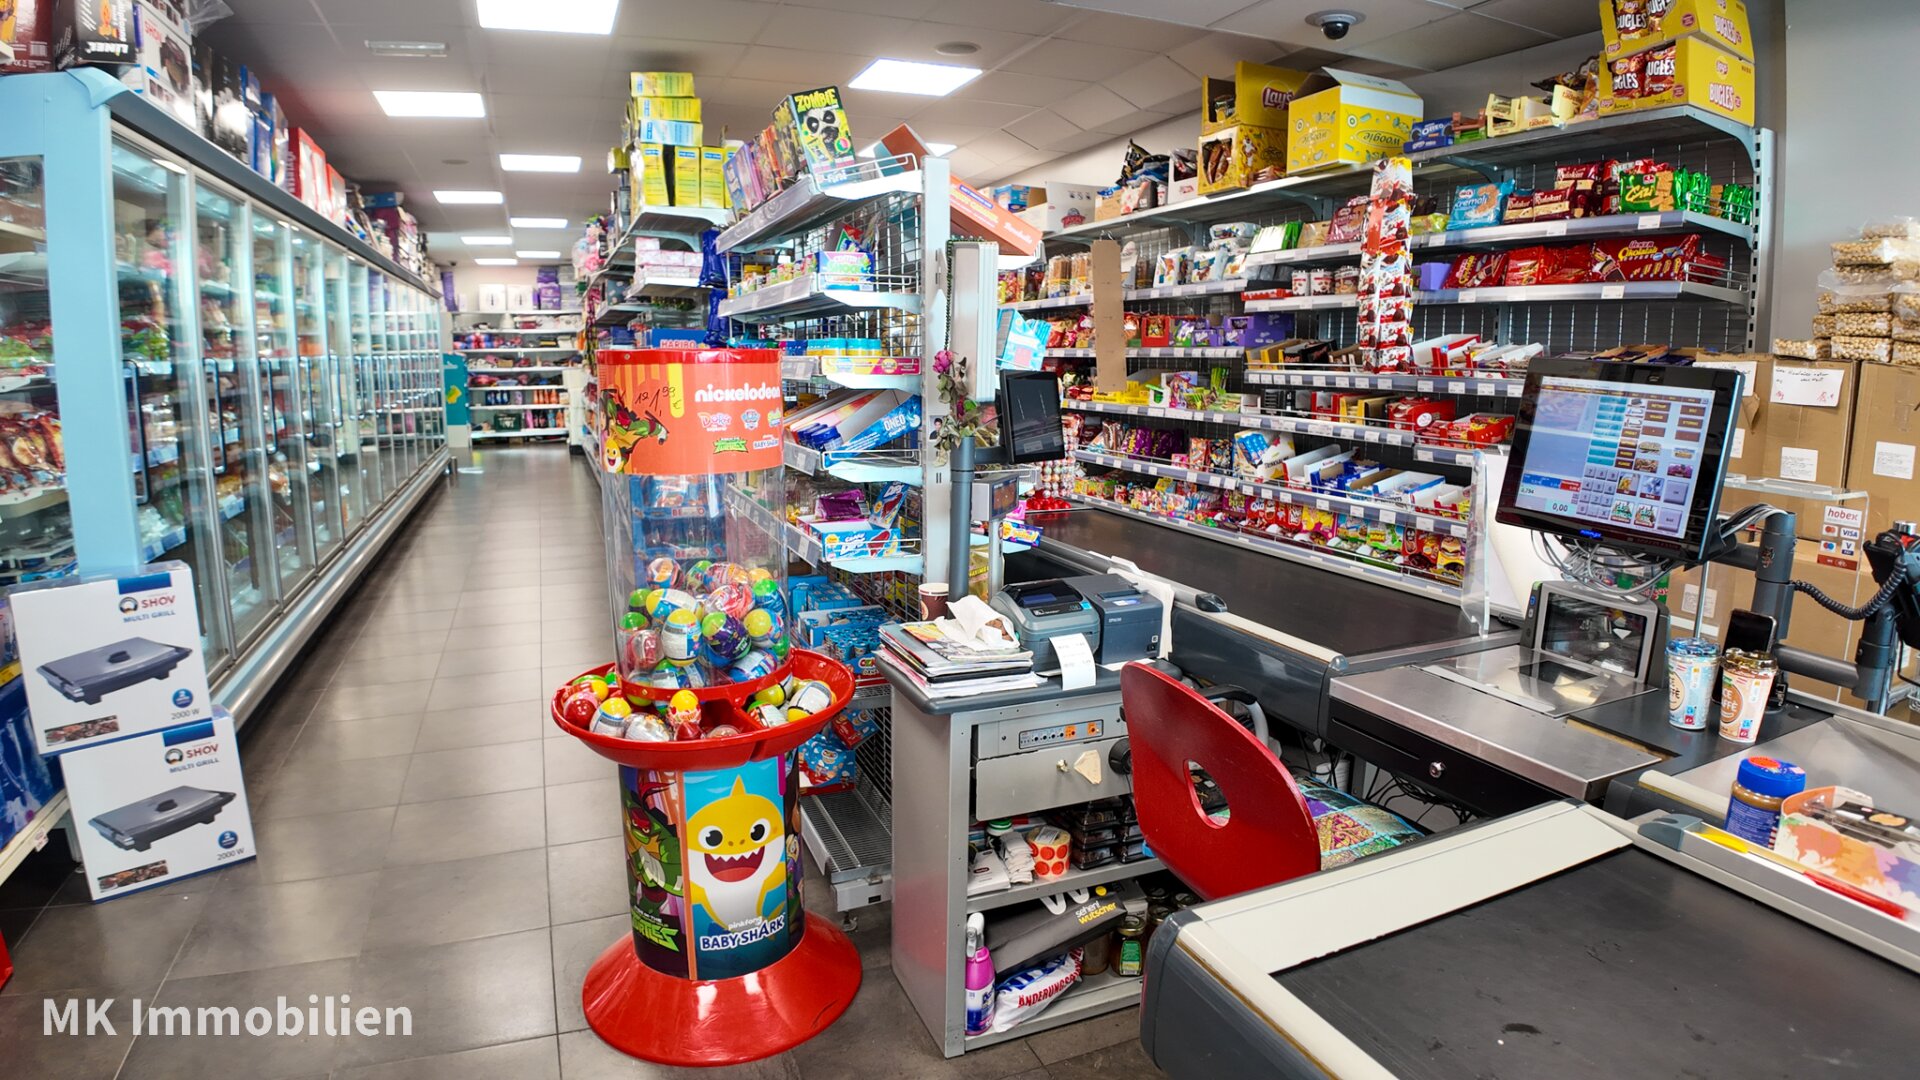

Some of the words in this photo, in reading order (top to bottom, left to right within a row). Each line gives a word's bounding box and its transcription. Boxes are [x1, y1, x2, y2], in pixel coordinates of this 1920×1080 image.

[794, 88, 838, 113] ZOMBIE
[1710, 82, 1735, 112] BUGLES
[1421, 124, 1444, 135] OREO
[660, 340, 695, 348] HARIBO
[695, 383, 781, 402] nickelodeon
[1552, 503, 1568, 512] 0,00
[1828, 508, 1859, 520] hobex
[1843, 530, 1858, 538] VISA
[141, 596, 176, 609] SHOV
[123, 614, 150, 623] MULTI
[152, 610, 176, 619] GRILL
[171, 710, 192, 720] 2000
[191, 707, 200, 716] W
[186, 744, 219, 758] SHOV
[169, 764, 195, 773] MULTI
[196, 758, 219, 768] GRILL
[217, 851, 236, 861] 2000
[1078, 902, 1117, 924] wutscher
[728, 916, 762, 931] pinkfong
[701, 932, 739, 950] BABY
[740, 916, 784, 944] SHARK
